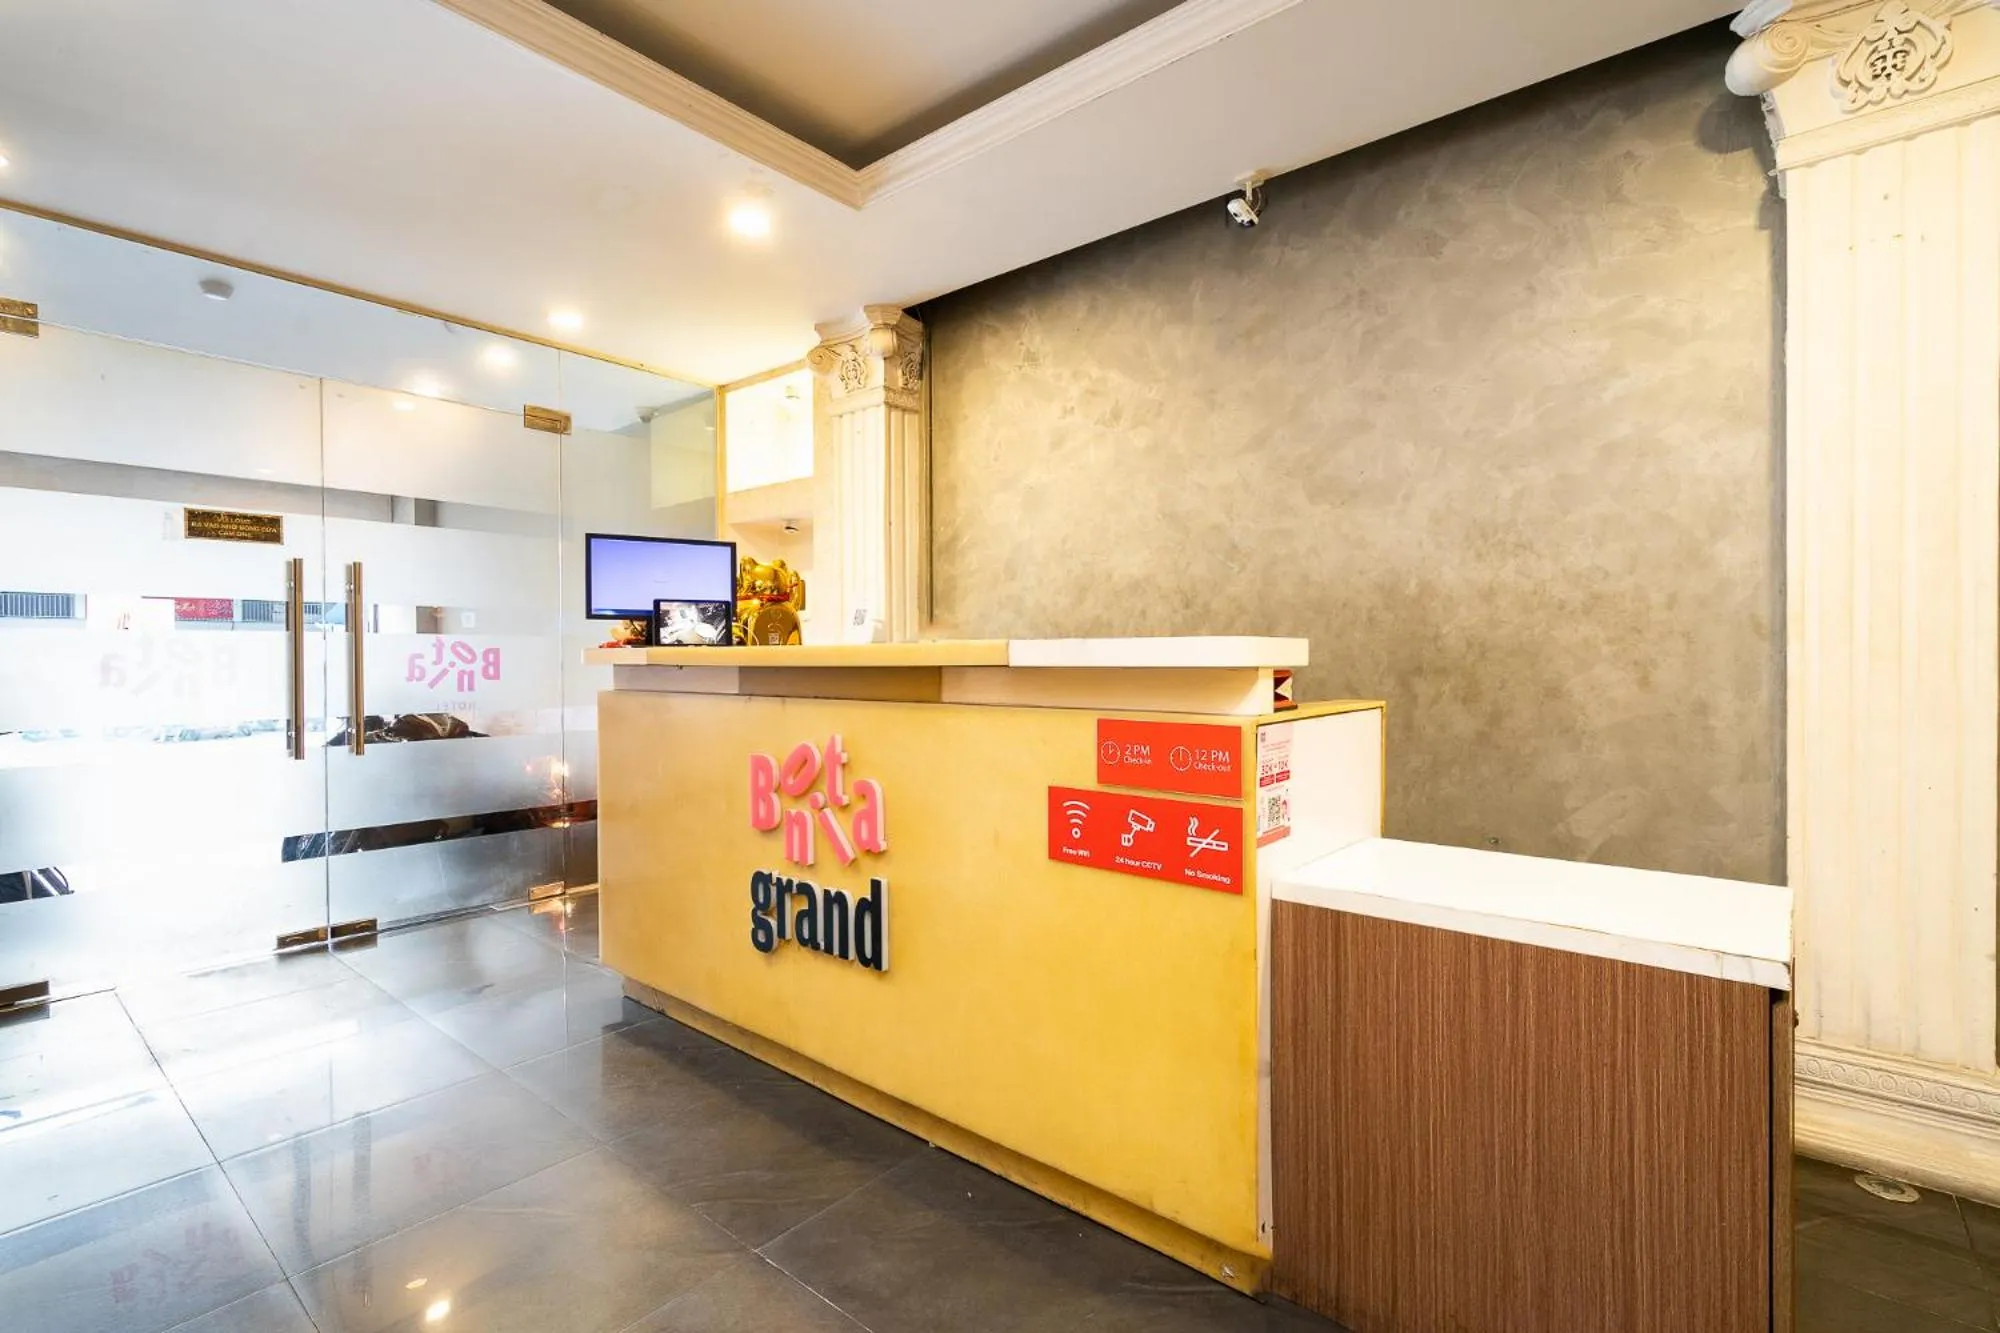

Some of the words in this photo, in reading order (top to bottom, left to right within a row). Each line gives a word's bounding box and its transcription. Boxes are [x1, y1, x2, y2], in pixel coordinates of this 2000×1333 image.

[1124, 744, 1132, 755] 2
[1134, 744, 1151, 756] PM
[1194, 749, 1207, 761] 12
[1211, 750, 1230, 763] PM
[1062, 846, 1077, 856] Free
[1115, 856, 1124, 864] 24
[1124, 857, 1141, 867] hour
[1141, 860, 1162, 871] CCTV
[1184, 868, 1195, 877] No
[1196, 870, 1231, 885] Smoking
[751, 869, 889, 972] grand
